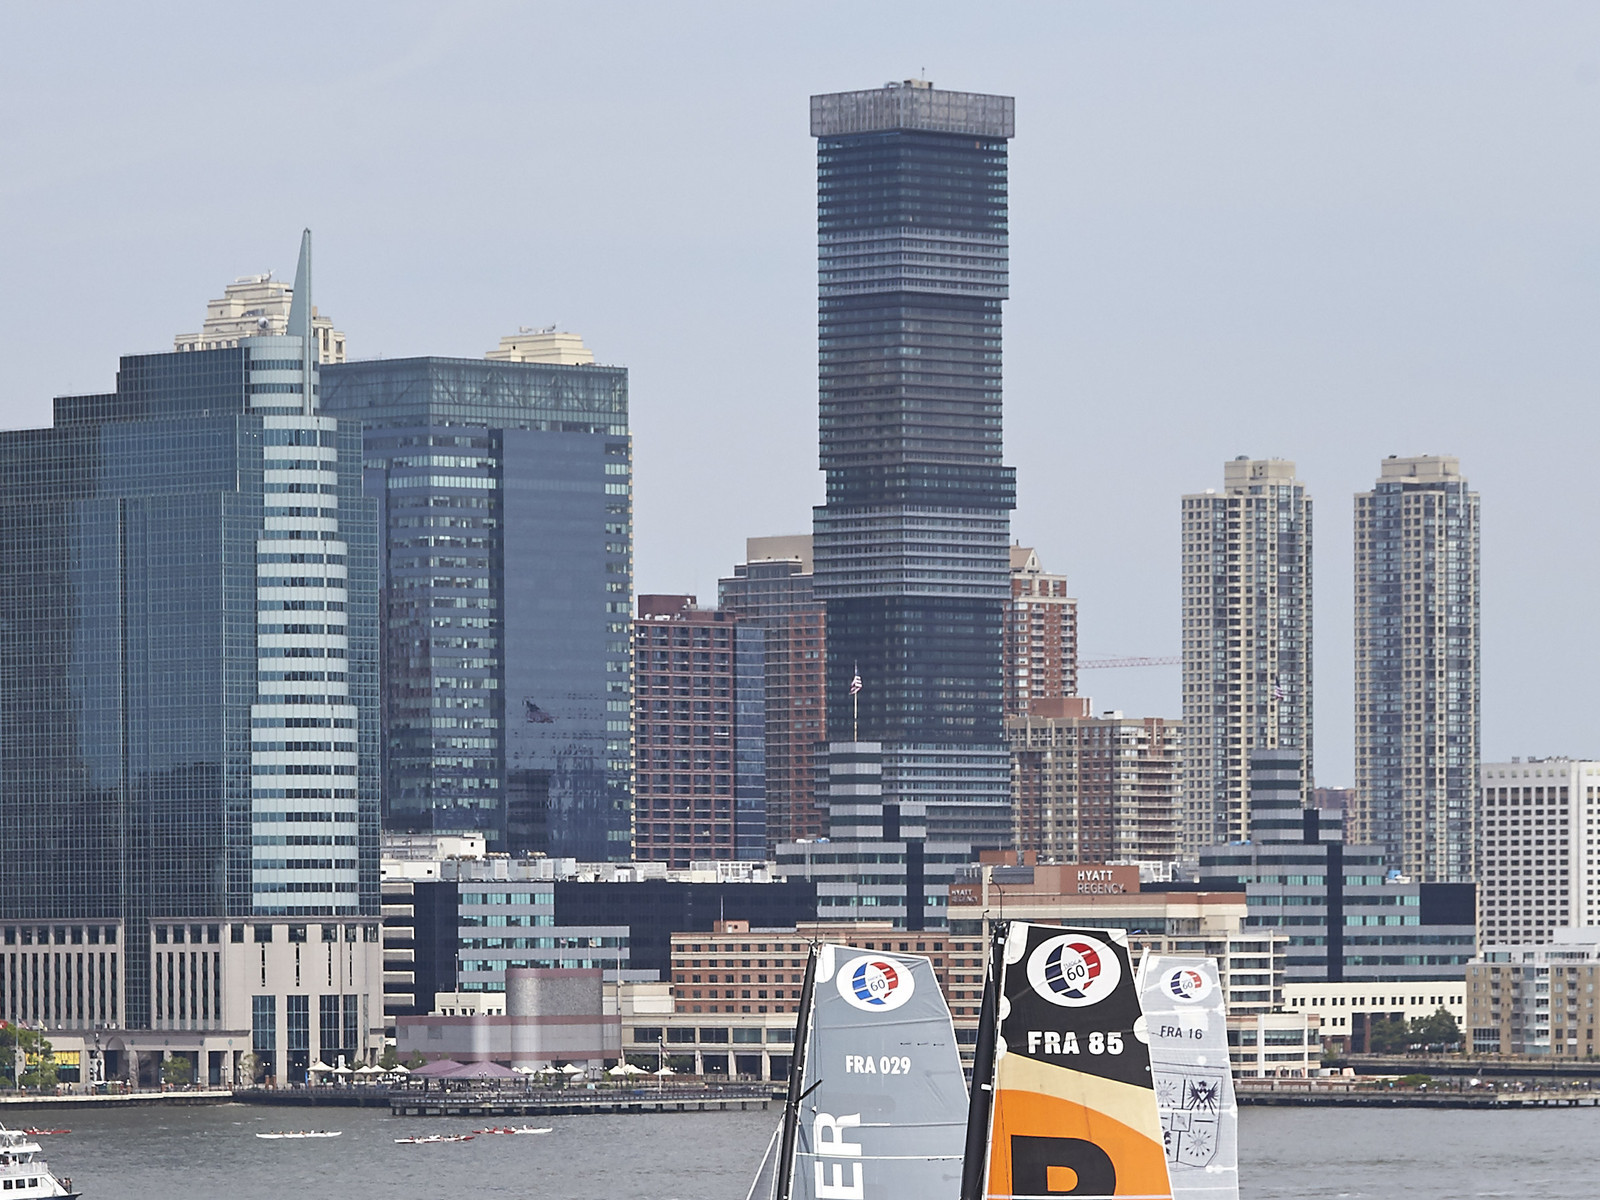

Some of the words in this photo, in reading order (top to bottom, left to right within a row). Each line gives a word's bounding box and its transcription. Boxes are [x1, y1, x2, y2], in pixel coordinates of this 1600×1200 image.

[1077, 870, 1113, 881] HYATT
[1077, 884, 1124, 894] REGENCY
[1066, 965, 1085, 980] 60
[870, 979, 886, 991] 60
[1160, 1025, 1183, 1038] FRA
[1189, 1028, 1203, 1039] 16
[1027, 1031, 1080, 1054] FRA
[1088, 1031, 1124, 1055] 85
[845, 1055, 876, 1074] FRA
[880, 1056, 911, 1074] 029
